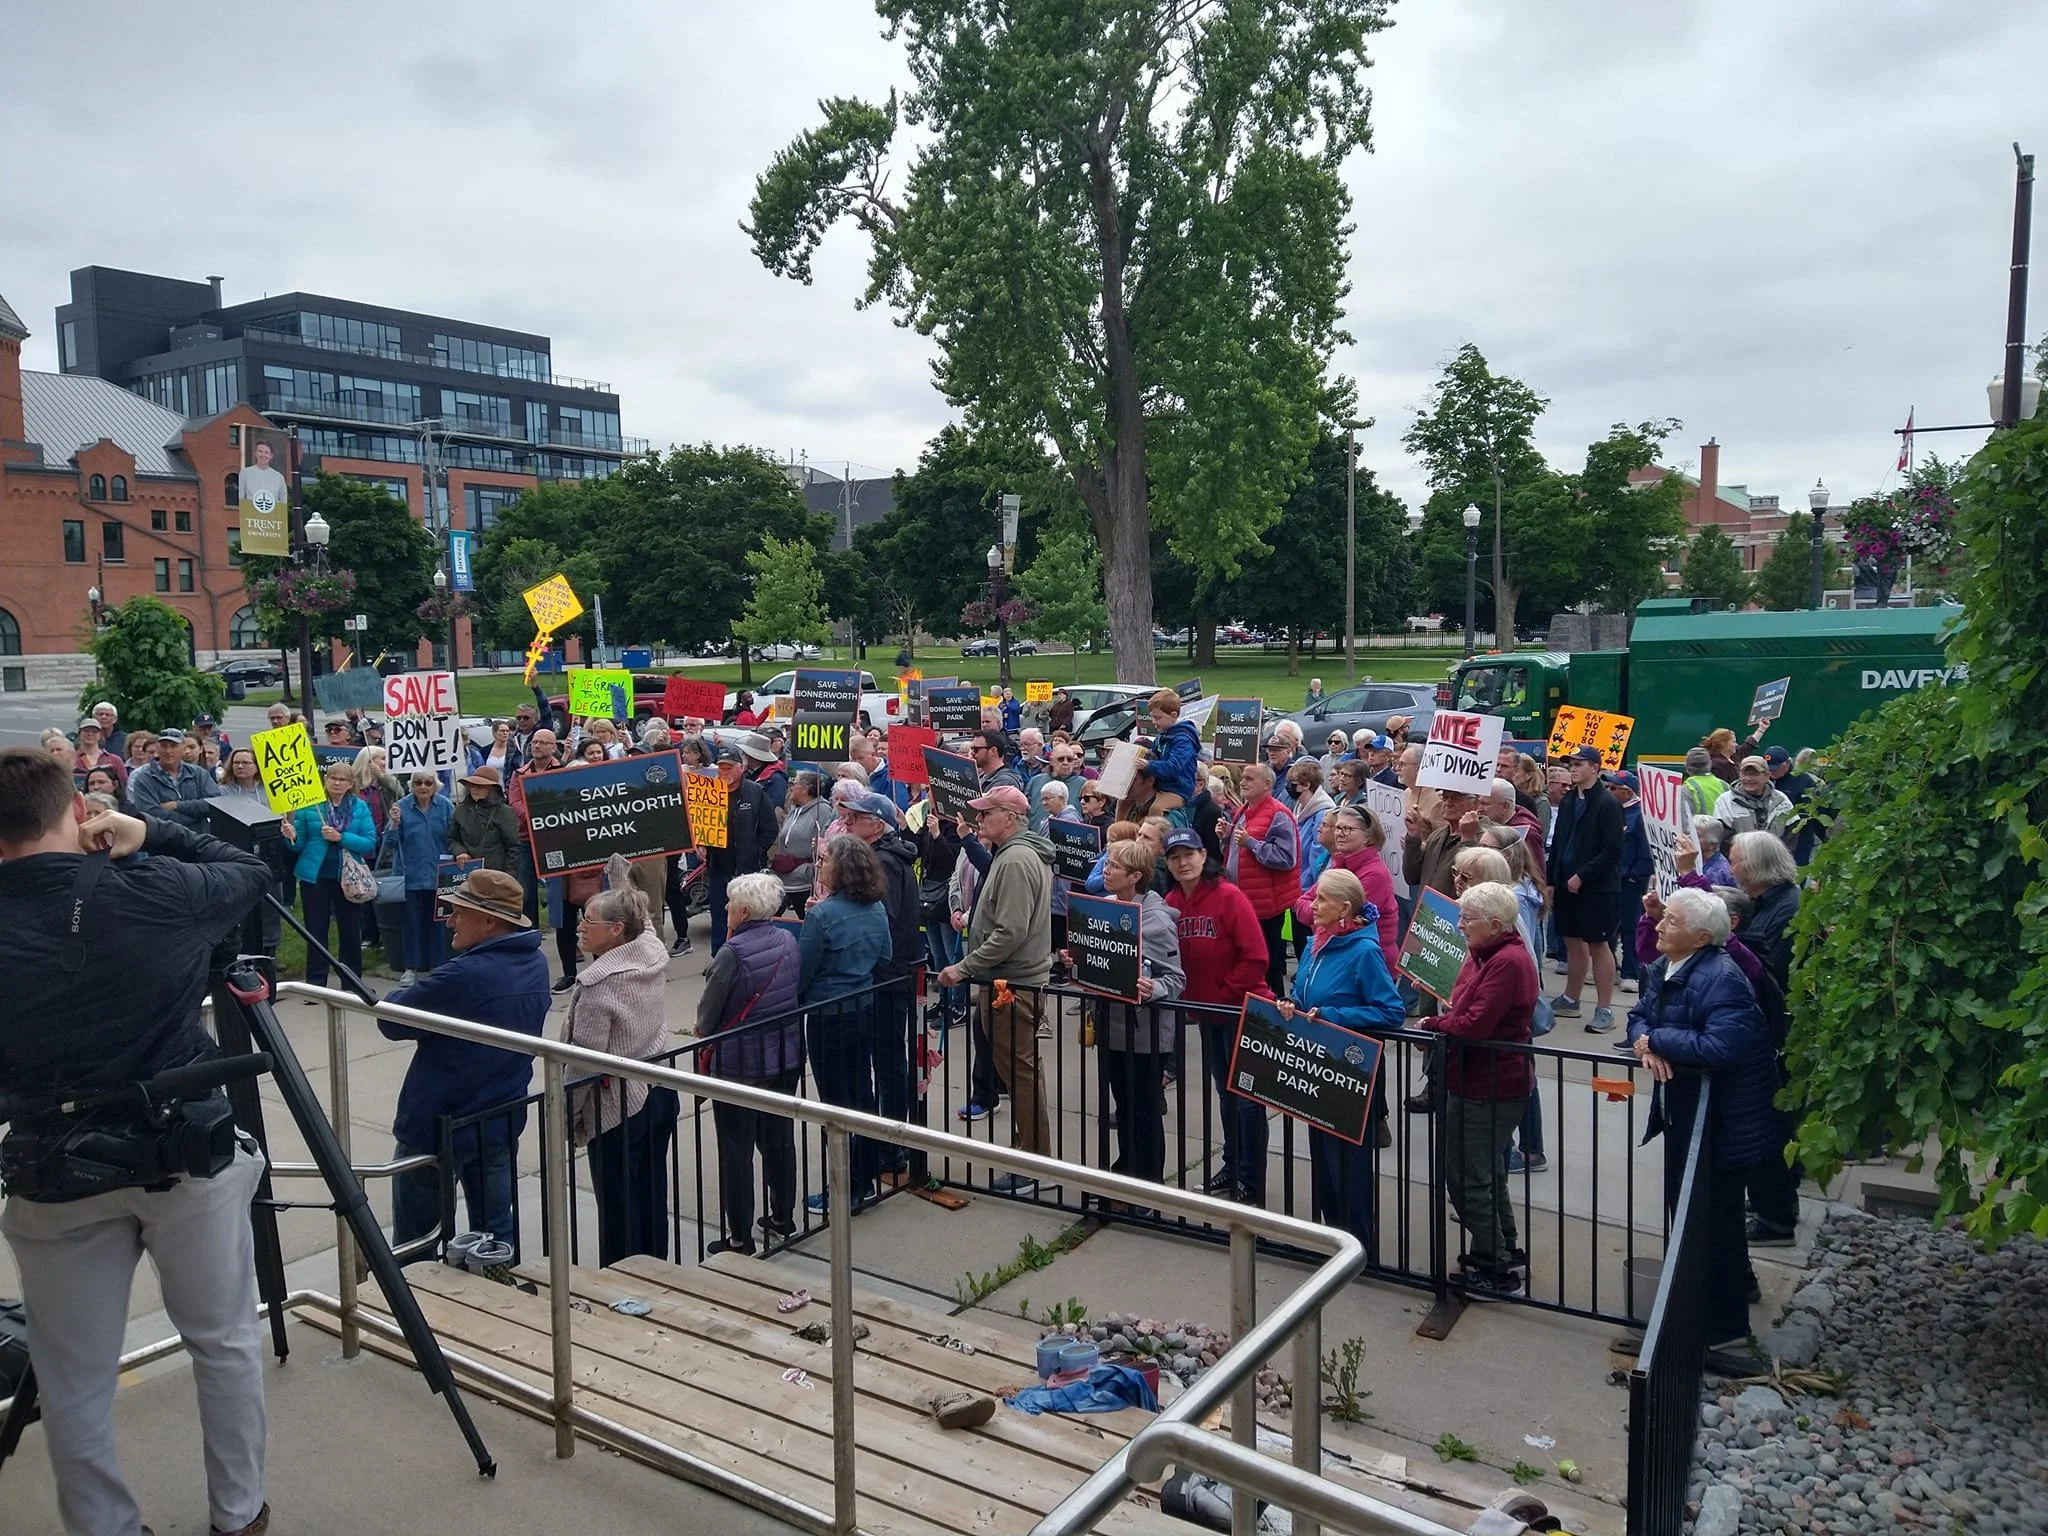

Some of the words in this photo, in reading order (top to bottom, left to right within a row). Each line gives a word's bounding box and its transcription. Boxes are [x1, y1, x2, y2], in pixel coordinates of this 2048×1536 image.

[245, 518, 283, 531] TRENT
[385, 674, 453, 717] SAVE
[795, 690, 858, 700] BONNERWORTH
[817, 681, 838, 689] SAVE
[815, 701, 837, 710] PARK
[929, 705, 980, 713] BONNERWORTH
[393, 714, 449, 741] DON'T
[1230, 713, 1245, 722] SAVE
[797, 723, 845, 750] HONK
[1216, 725, 1259, 736] BONNERWORTH
[1430, 714, 1483, 750] UNITE
[388, 728, 459, 770] PAVE!
[1228, 738, 1244, 748] PARK
[942, 767, 961, 781] SAVE
[1443, 755, 1493, 780] DIVIDE
[580, 782, 629, 802] SAVE
[687, 786, 727, 807] ERASE
[929, 775, 981, 799] BONNERWORTH
[1639, 767, 1683, 827] NOT
[531, 792, 683, 831] BONNERWORTH
[948, 794, 967, 810] PARK
[586, 820, 637, 842] PARK
[693, 825, 727, 848] PACE
[1065, 834, 1082, 846] SAVE
[1066, 857, 1084, 869] PARK
[71, 898, 84, 934] SONY
[1088, 917, 1110, 933] SAVE
[1432, 915, 1453, 935] SAVE
[1068, 930, 1138, 957] BONNERWORTH
[1410, 921, 1466, 963] BONNERWORTH
[1086, 953, 1110, 971] PARK
[1420, 947, 1441, 968] PARK
[1285, 1032, 1327, 1059] SAVE
[1239, 1034, 1369, 1097] BONNERWORTH
[1276, 1070, 1321, 1099] PARK
